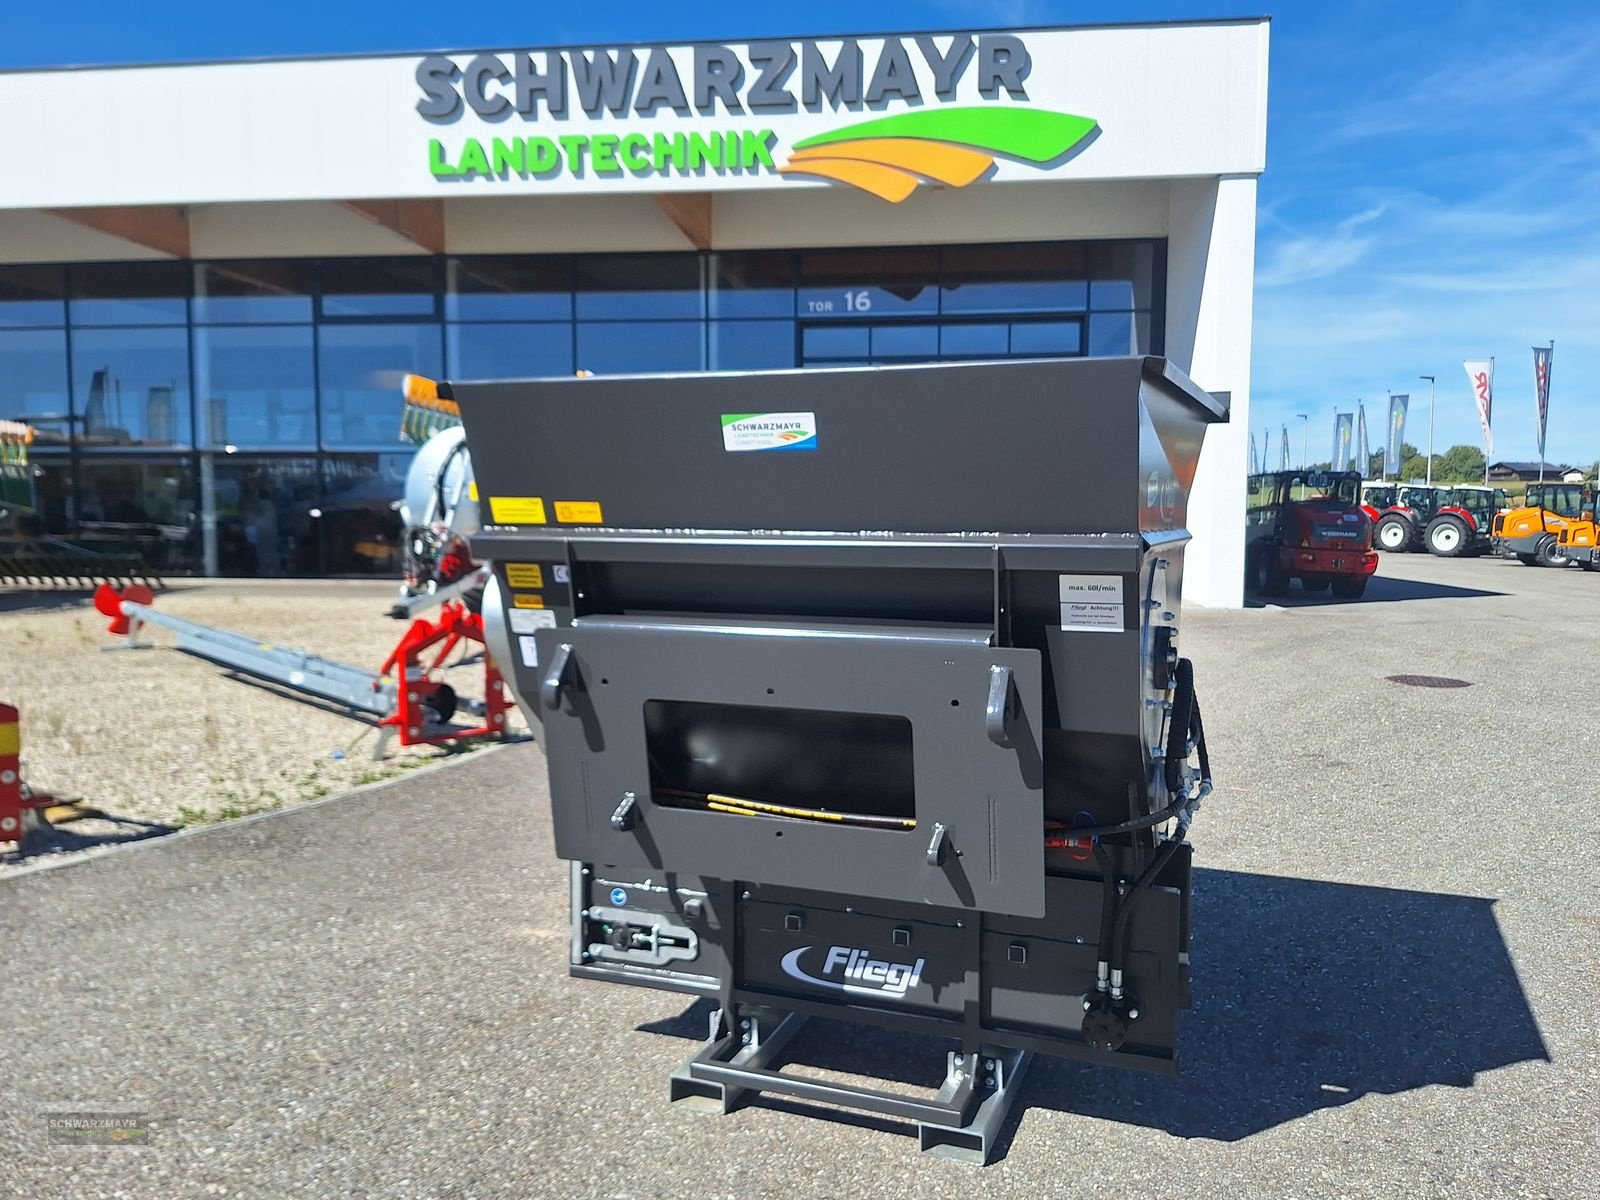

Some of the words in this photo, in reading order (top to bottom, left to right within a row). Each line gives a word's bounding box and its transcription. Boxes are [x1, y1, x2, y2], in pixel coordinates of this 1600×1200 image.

[415, 33, 1029, 120] SCHWARZMAYR
[428, 130, 774, 180] LANDTECHNIK
[808, 301, 833, 312] TOR
[844, 291, 871, 312] 16
[731, 422, 802, 432] SCHWARZMAYR
[1087, 584, 1116, 593] 60l/min
[822, 946, 926, 993] Fliegl
